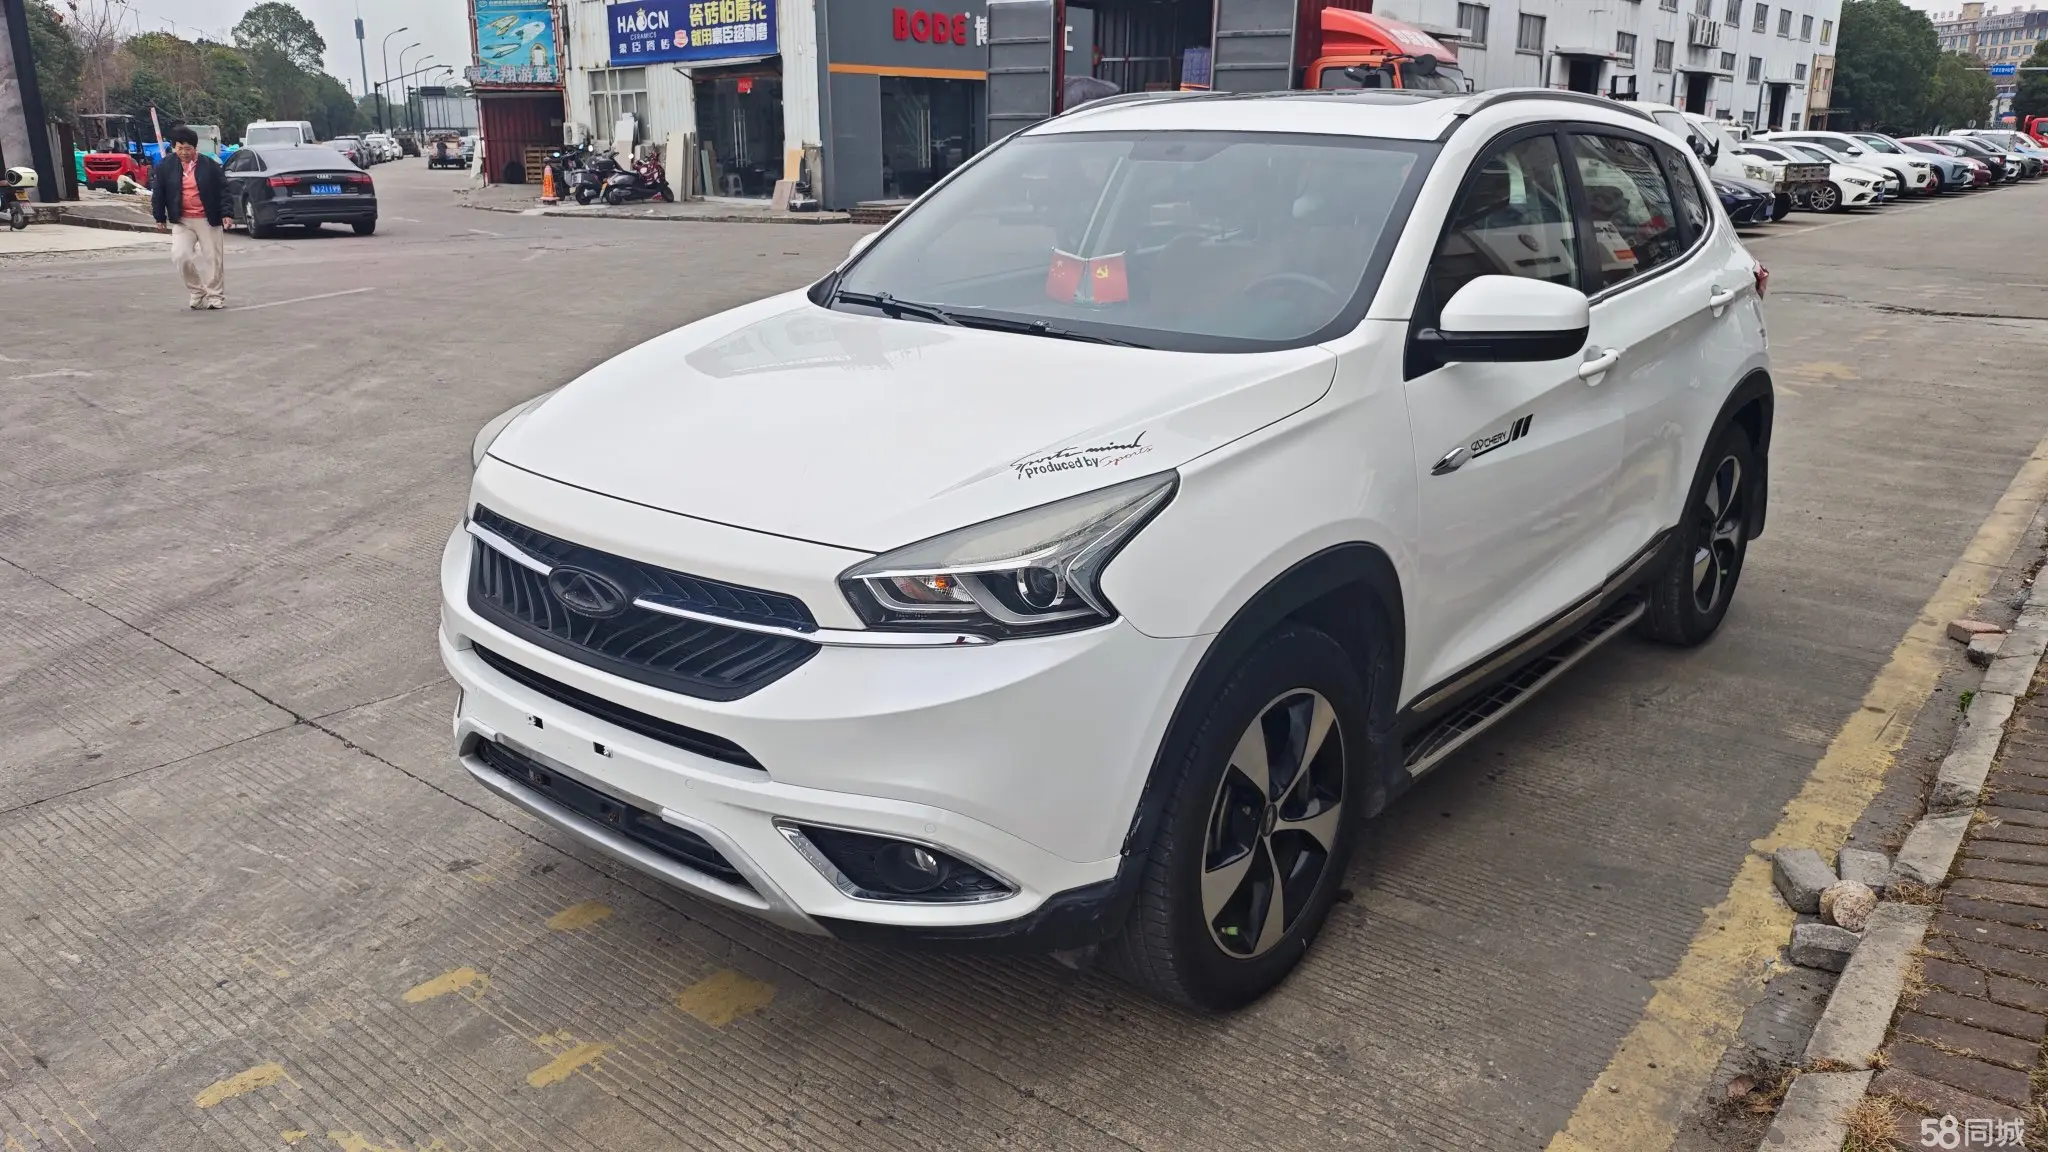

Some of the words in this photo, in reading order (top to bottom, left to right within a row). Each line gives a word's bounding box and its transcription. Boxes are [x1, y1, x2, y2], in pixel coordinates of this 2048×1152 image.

[689, 0, 767, 27] 瓷砖怕磨化
[630, 31, 657, 41] CERAMICS
[893, 7, 967, 45] BODE
[1085, 430, 1147, 454] mind
[1484, 431, 1507, 448] CHERY
[1025, 457, 1084, 479] produced
[1085, 456, 1101, 468] by
